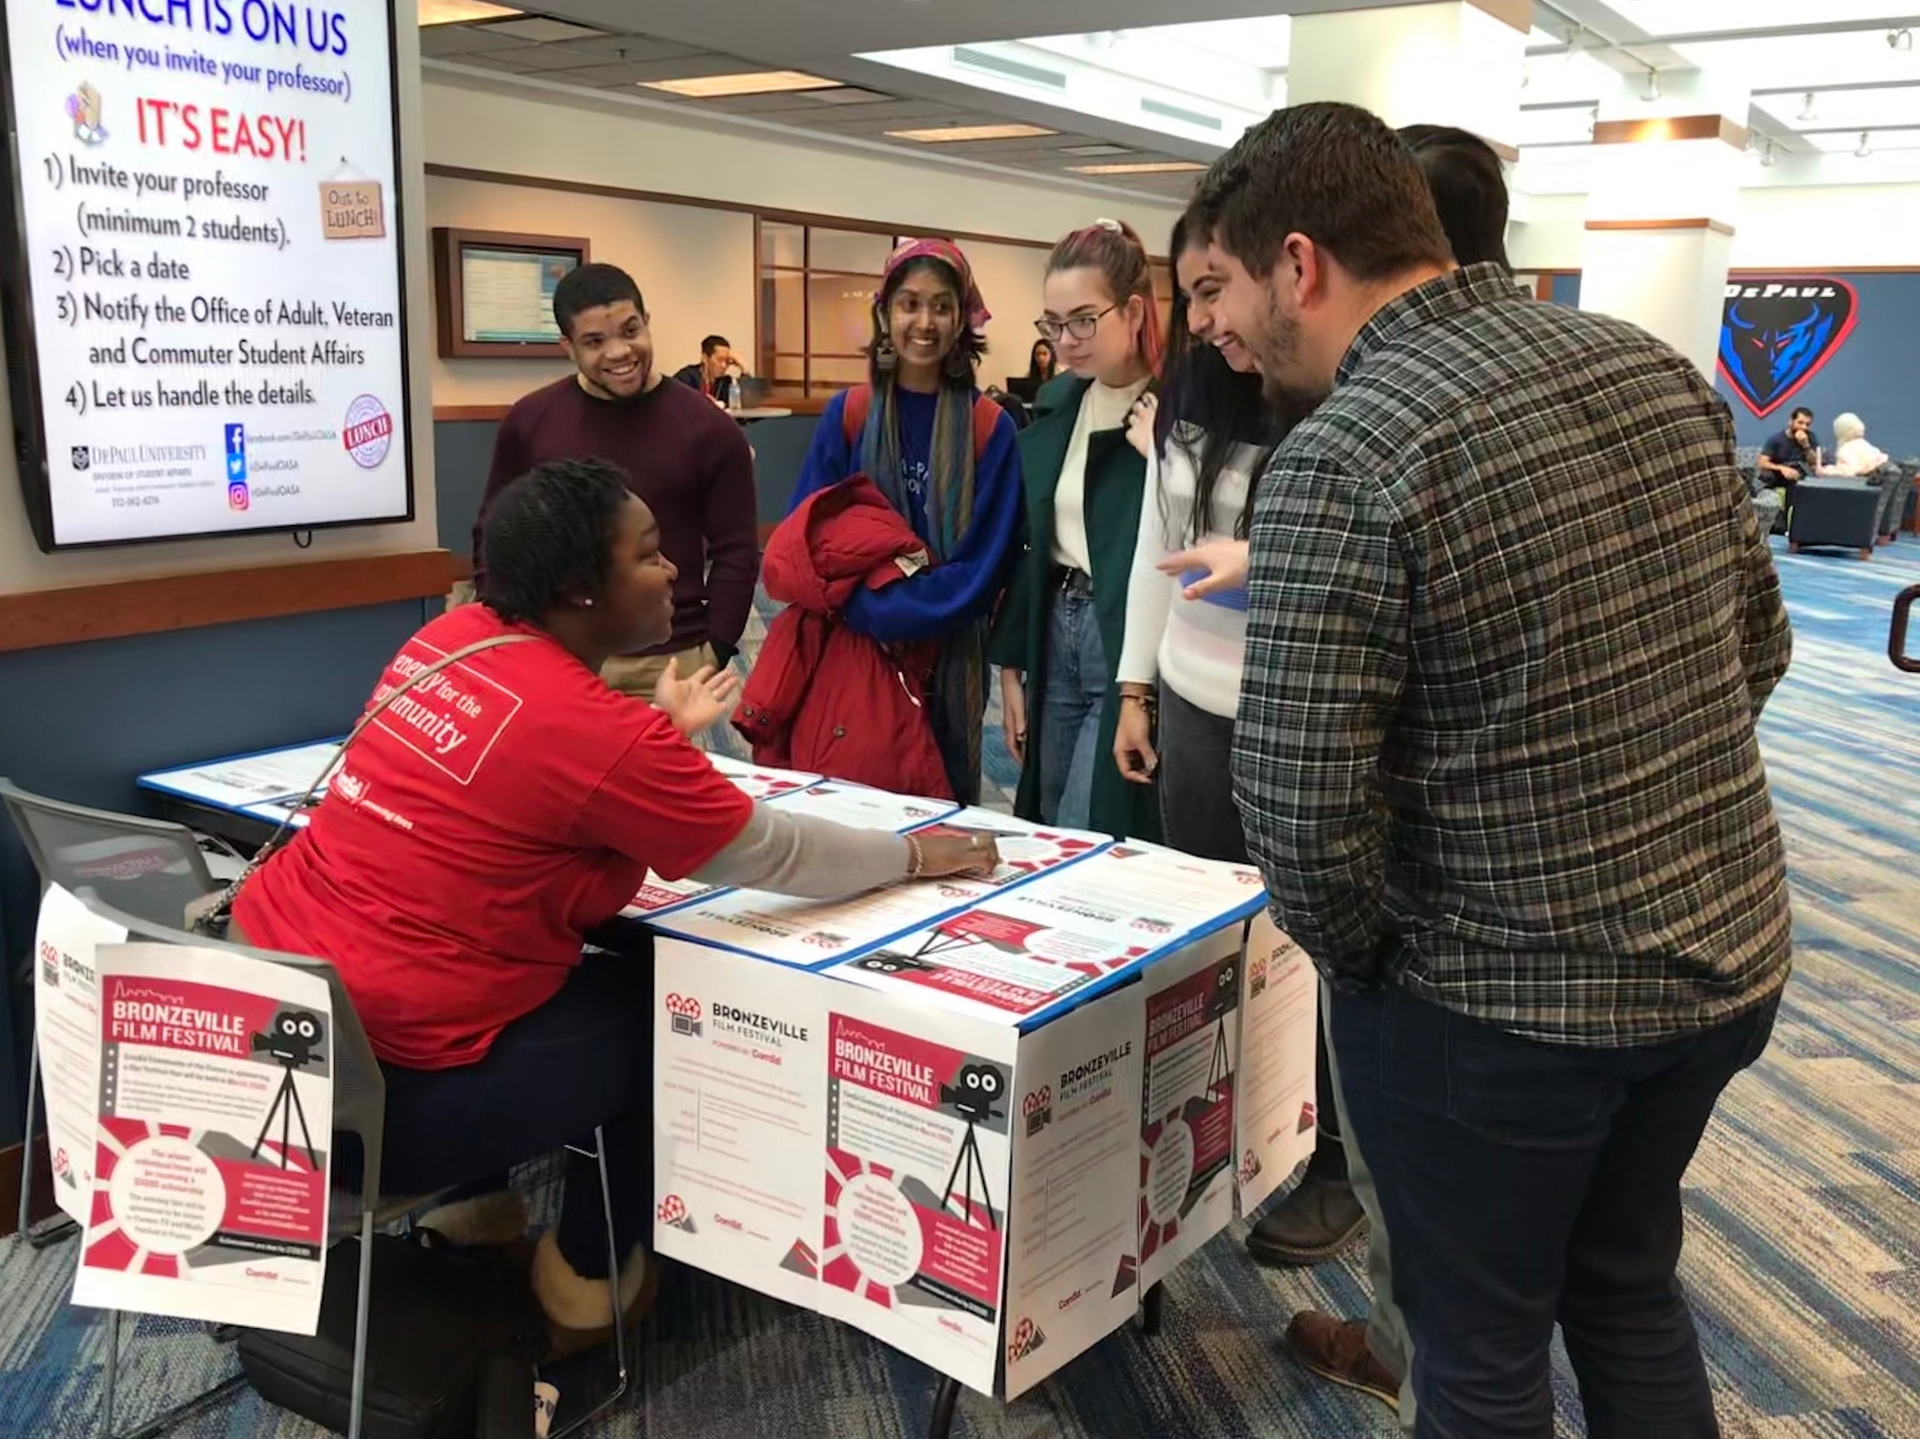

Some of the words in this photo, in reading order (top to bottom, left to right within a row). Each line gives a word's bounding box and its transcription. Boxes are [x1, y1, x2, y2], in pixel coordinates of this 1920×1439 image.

[204, 0, 232, 35] IS
[242, 0, 297, 46] ON
[306, 7, 348, 56] US
[56, 23, 119, 62] (when
[123, 44, 160, 71] you
[165, 44, 217, 76] invite
[221, 61, 261, 85] your
[267, 63, 352, 103] professor)
[136, 97, 202, 151] IT'S
[210, 107, 306, 163] EASY!
[43, 151, 64, 190] 1)
[69, 154, 129, 188] Invite
[133, 171, 177, 197] your
[183, 169, 270, 202] professor
[329, 190, 352, 205] Out
[355, 190, 369, 205] to
[77, 201, 182, 239] (minimum
[186, 215, 197, 238] 2
[202, 215, 291, 250] students).
[52, 245, 74, 282] 2)
[80, 246, 124, 277] Pick
[131, 260, 142, 278] a
[147, 250, 190, 280] date
[56, 290, 78, 327] 3)
[84, 291, 149, 329] Notify
[155, 294, 186, 322] the
[191, 296, 249, 324] Office
[254, 299, 271, 323] of
[332, 301, 394, 327] Veteran
[89, 337, 126, 364] and
[132, 337, 234, 364] Commuter
[238, 338, 306, 364] Student
[311, 340, 365, 365] Affairs
[65, 380, 86, 416] 4)
[93, 379, 126, 408] Let
[132, 389, 152, 407] us
[157, 379, 220, 407] handle
[225, 379, 253, 405] the
[257, 378, 316, 405] details.
[435, 680, 460, 702] for
[455, 693, 482, 718] the
[112, 1020, 158, 1041] FILM
[162, 1025, 244, 1054] FESTIVAL
[113, 1000, 245, 1036] BRONZEVILLE
[713, 1002, 808, 1042] BRONZEVILLE
[713, 1018, 734, 1032] FILM
[737, 1025, 783, 1048] FESTIVAL
[834, 1057, 866, 1082] FILM
[869, 1070, 932, 1105] FESTIVAL
[835, 1038, 934, 1087] BRONZEVILLE
[1060, 1040, 1132, 1089] BRONZEVILLE
